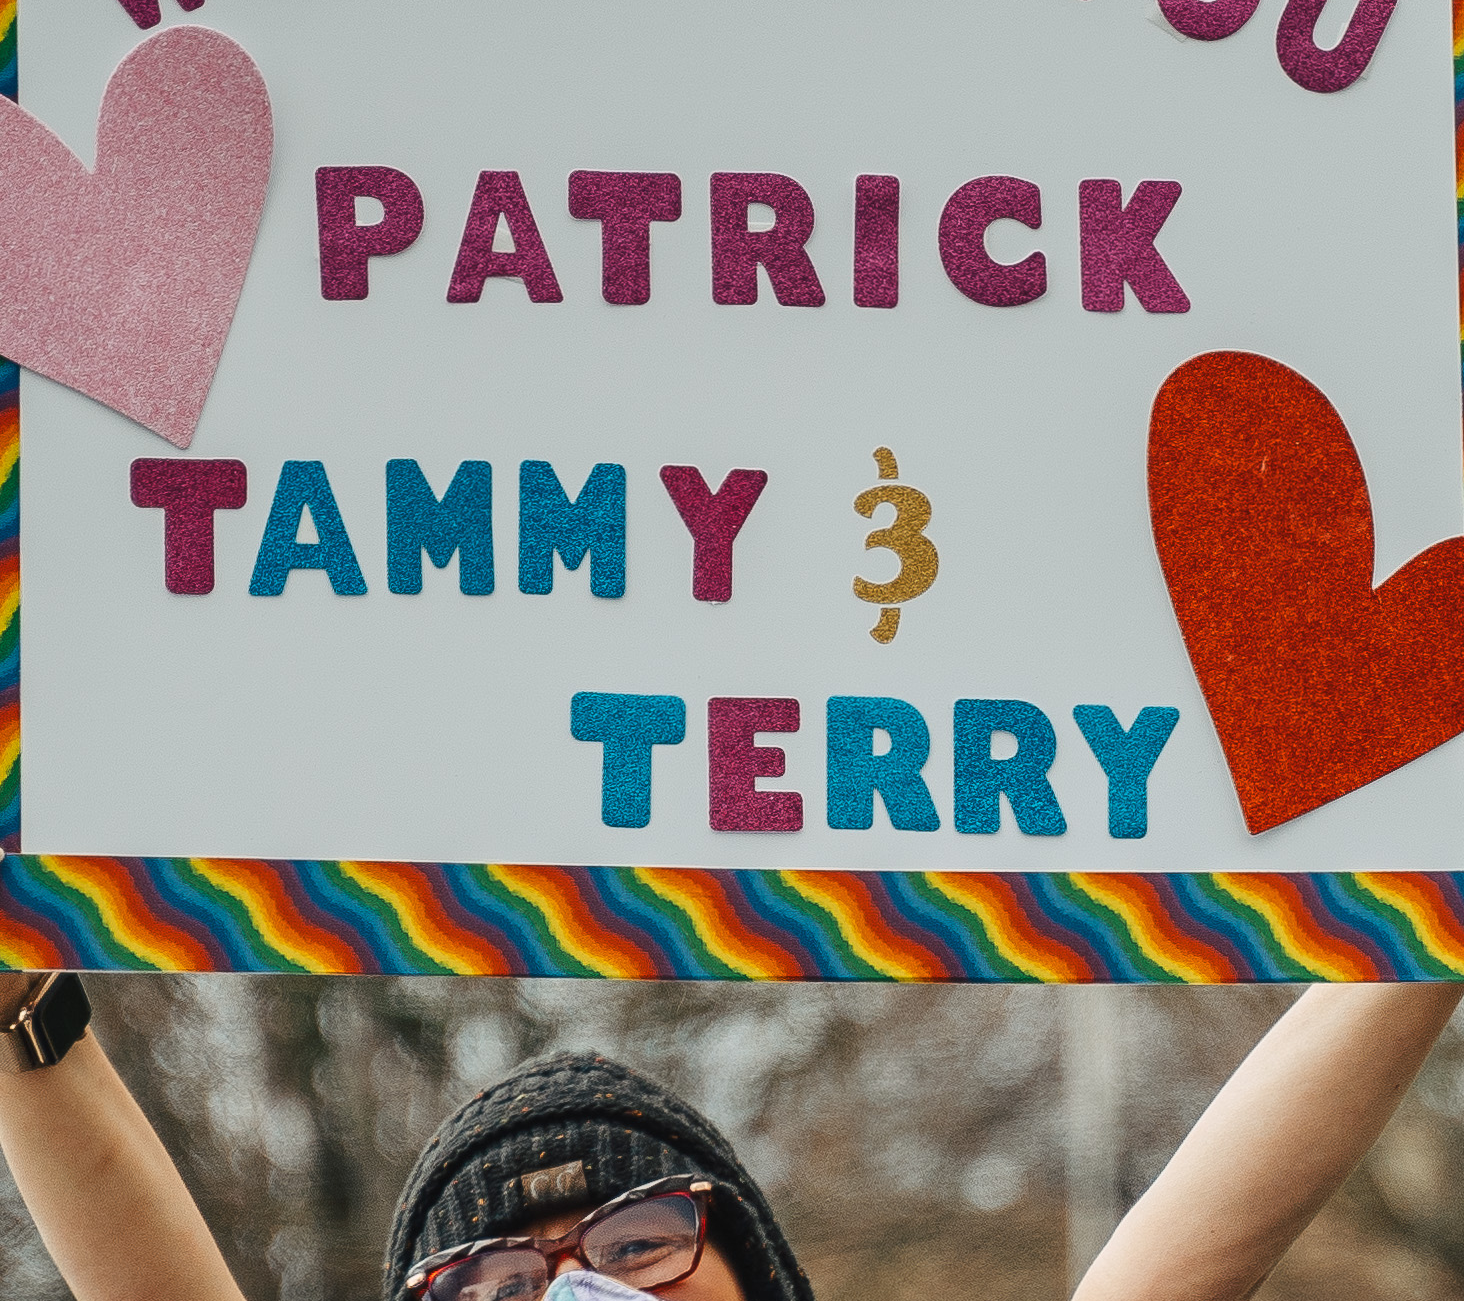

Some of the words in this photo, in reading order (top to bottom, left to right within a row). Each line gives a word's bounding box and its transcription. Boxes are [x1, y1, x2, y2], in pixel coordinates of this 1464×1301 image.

[315, 165, 1192, 315] PATRICK
[129, 457, 769, 604] TAMMY
[851, 447, 940, 646] &
[569, 689, 1182, 841] TERRY
